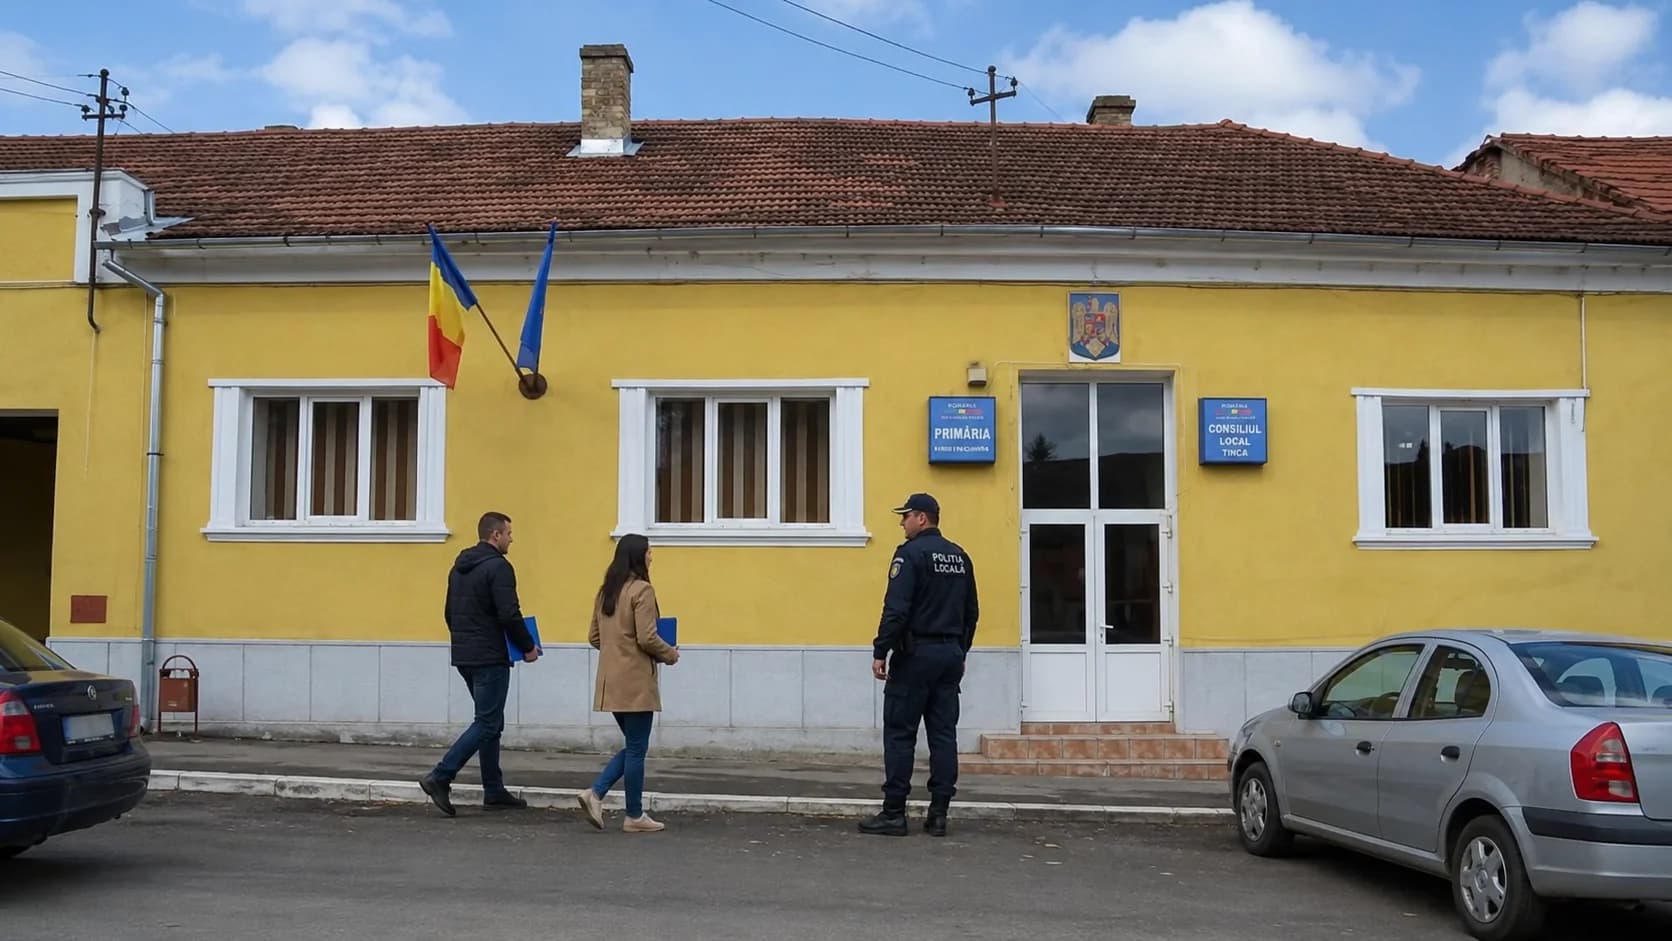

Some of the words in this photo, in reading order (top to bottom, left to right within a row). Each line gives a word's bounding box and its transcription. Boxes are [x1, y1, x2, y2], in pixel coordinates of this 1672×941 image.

[1208, 424, 1263, 434] CONSILIUL
[1219, 437, 1252, 446] LOCAL
[1222, 449, 1249, 457] TINCA
